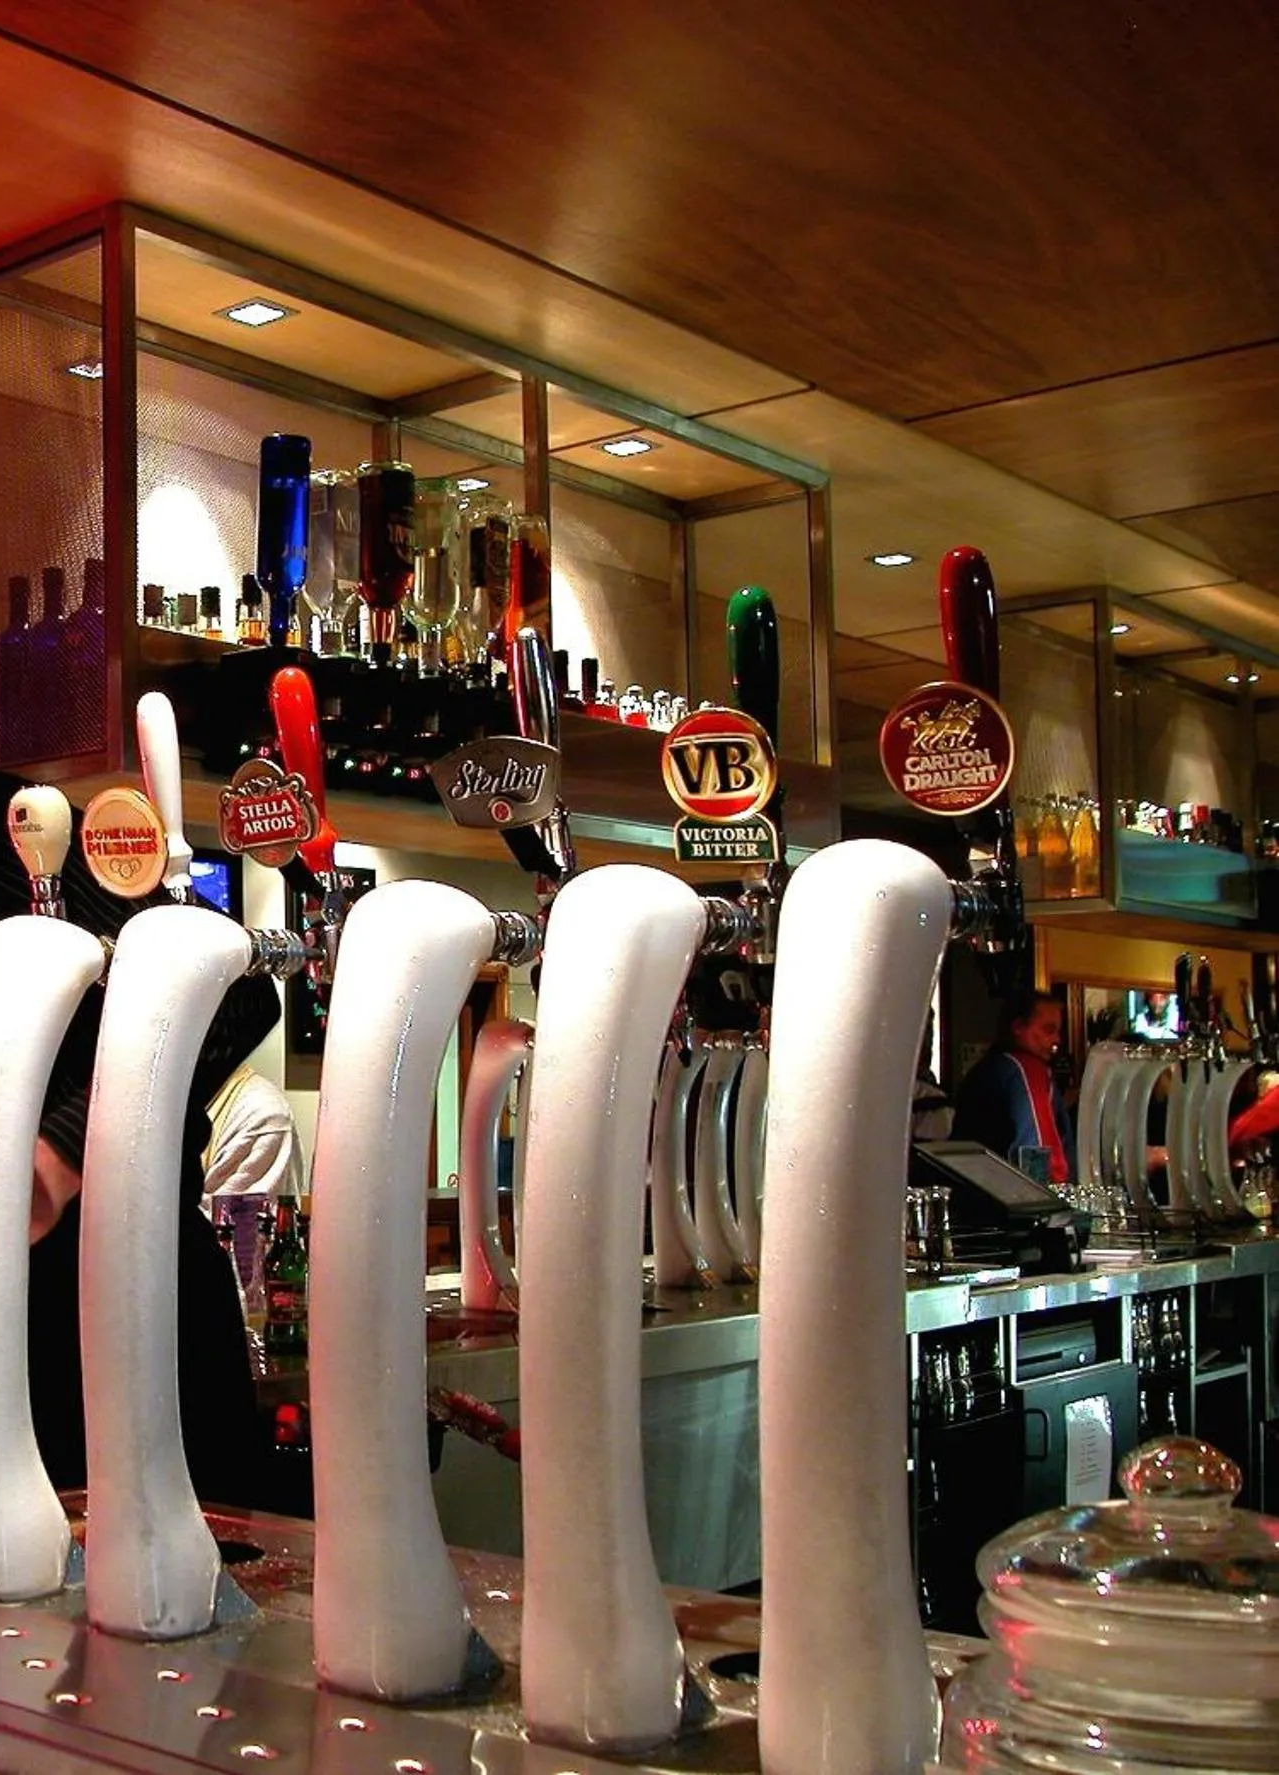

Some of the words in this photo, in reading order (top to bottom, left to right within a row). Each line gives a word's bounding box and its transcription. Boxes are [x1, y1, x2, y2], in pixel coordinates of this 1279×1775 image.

[668, 740, 758, 795] VB
[905, 748, 992, 773] CARLTON
[451, 758, 547, 806] Sterling
[903, 764, 997, 792] DRAUGHT
[239, 799, 292, 820] STELLA
[85, 827, 157, 841] BOHEMIAN
[243, 815, 296, 835] ARTOIS
[680, 826, 768, 842] VICTORIA
[692, 842, 760, 857] BITTER
